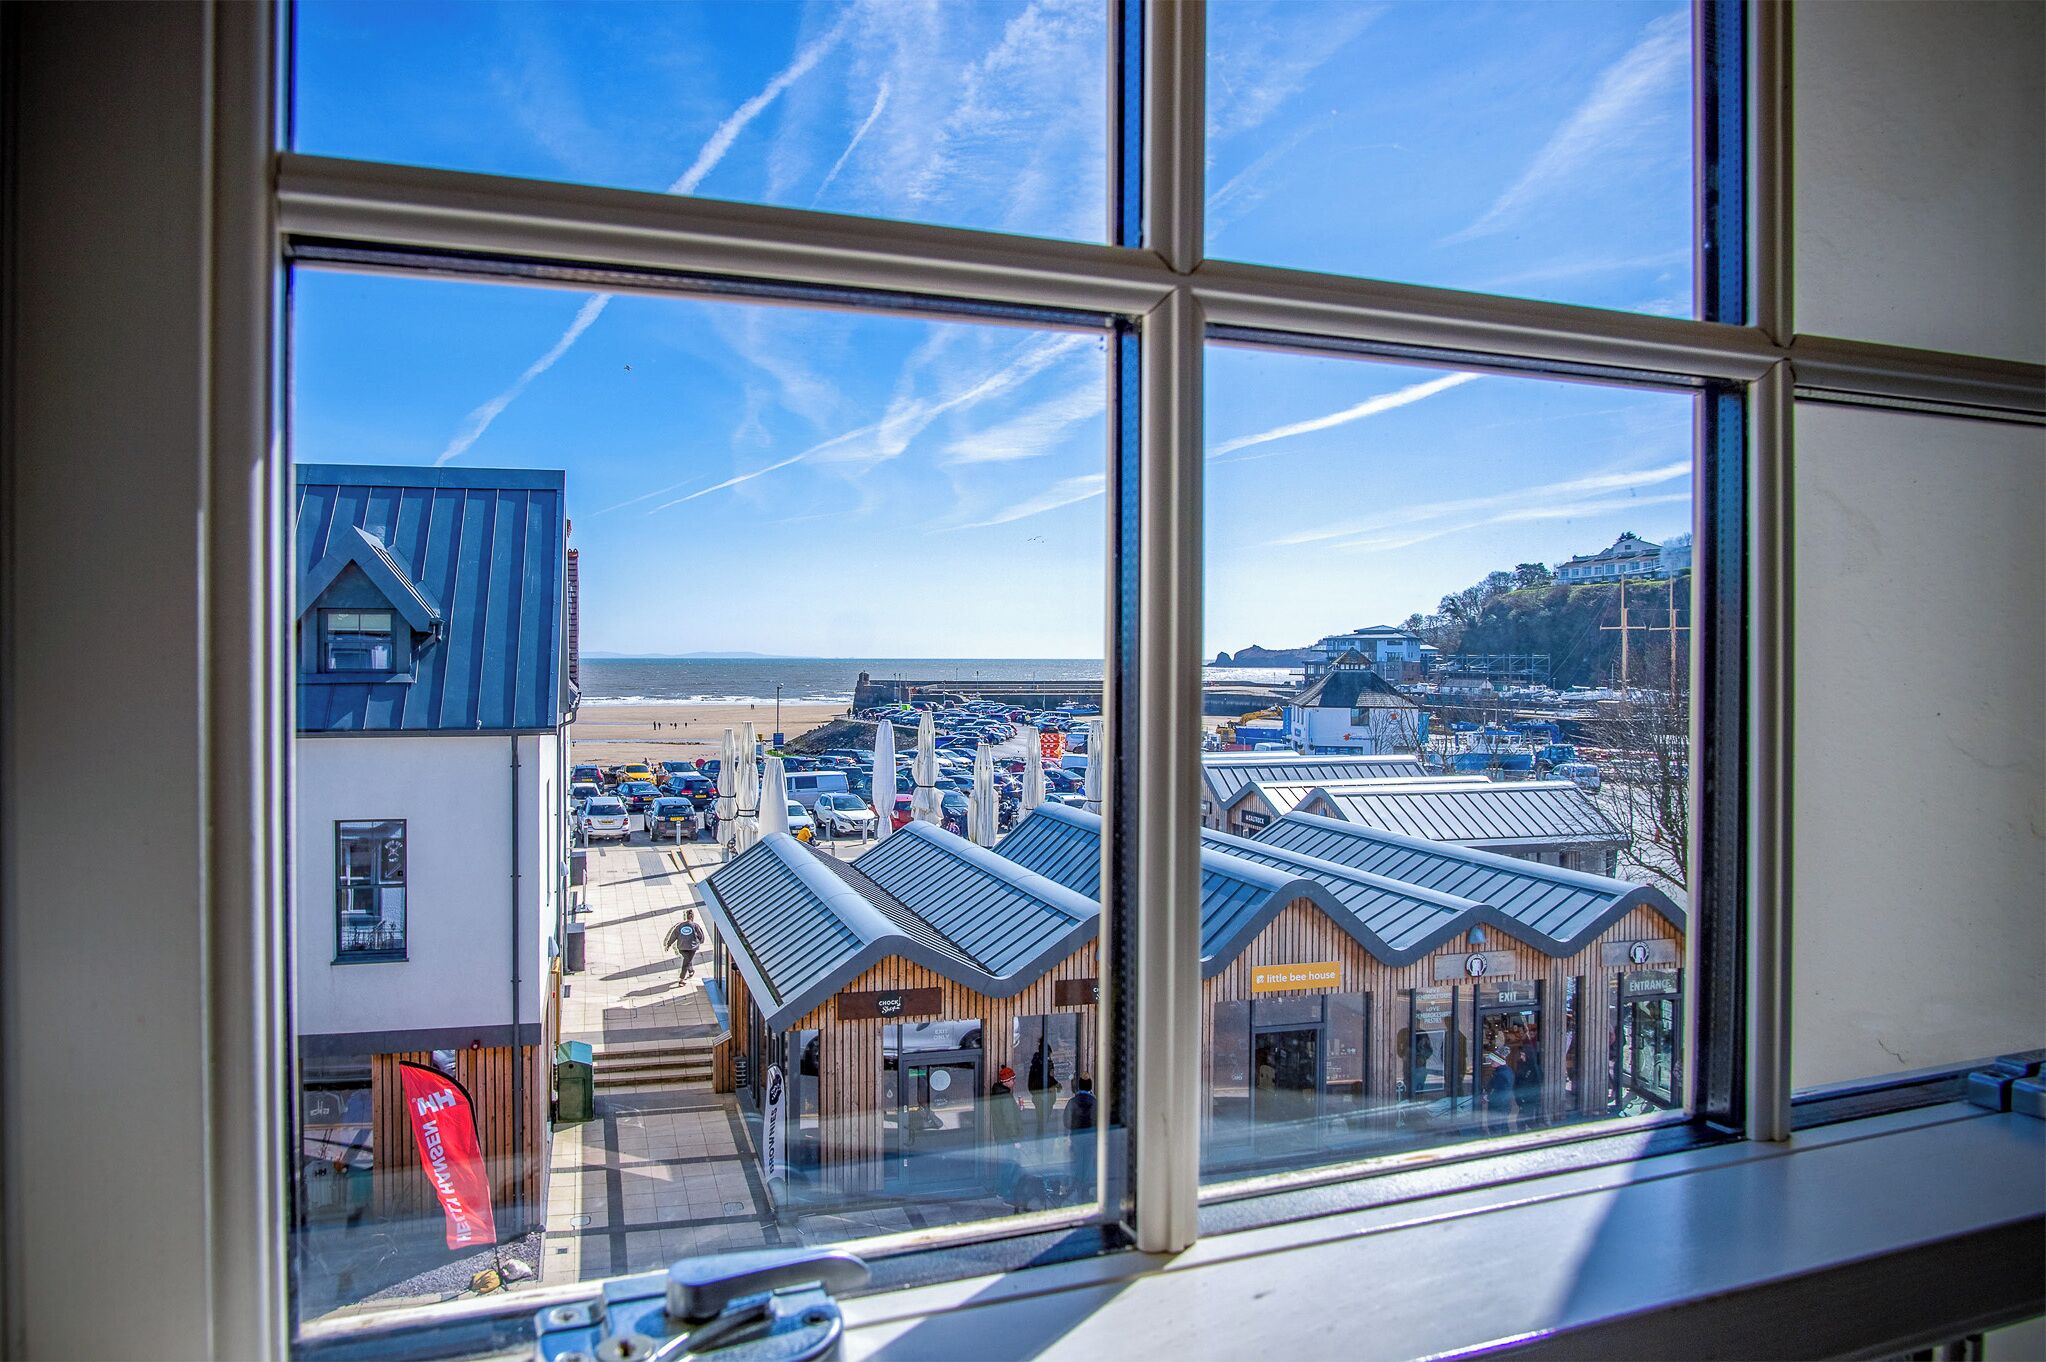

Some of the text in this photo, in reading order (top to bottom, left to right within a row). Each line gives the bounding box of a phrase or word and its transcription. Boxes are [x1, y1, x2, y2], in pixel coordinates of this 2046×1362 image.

[1266, 970, 1336, 984] little bee house
[1629, 979, 1671, 992] ENTRANCE
[1498, 991, 1518, 1003] EXIT
[768, 1107, 778, 1174] BROWNIES
